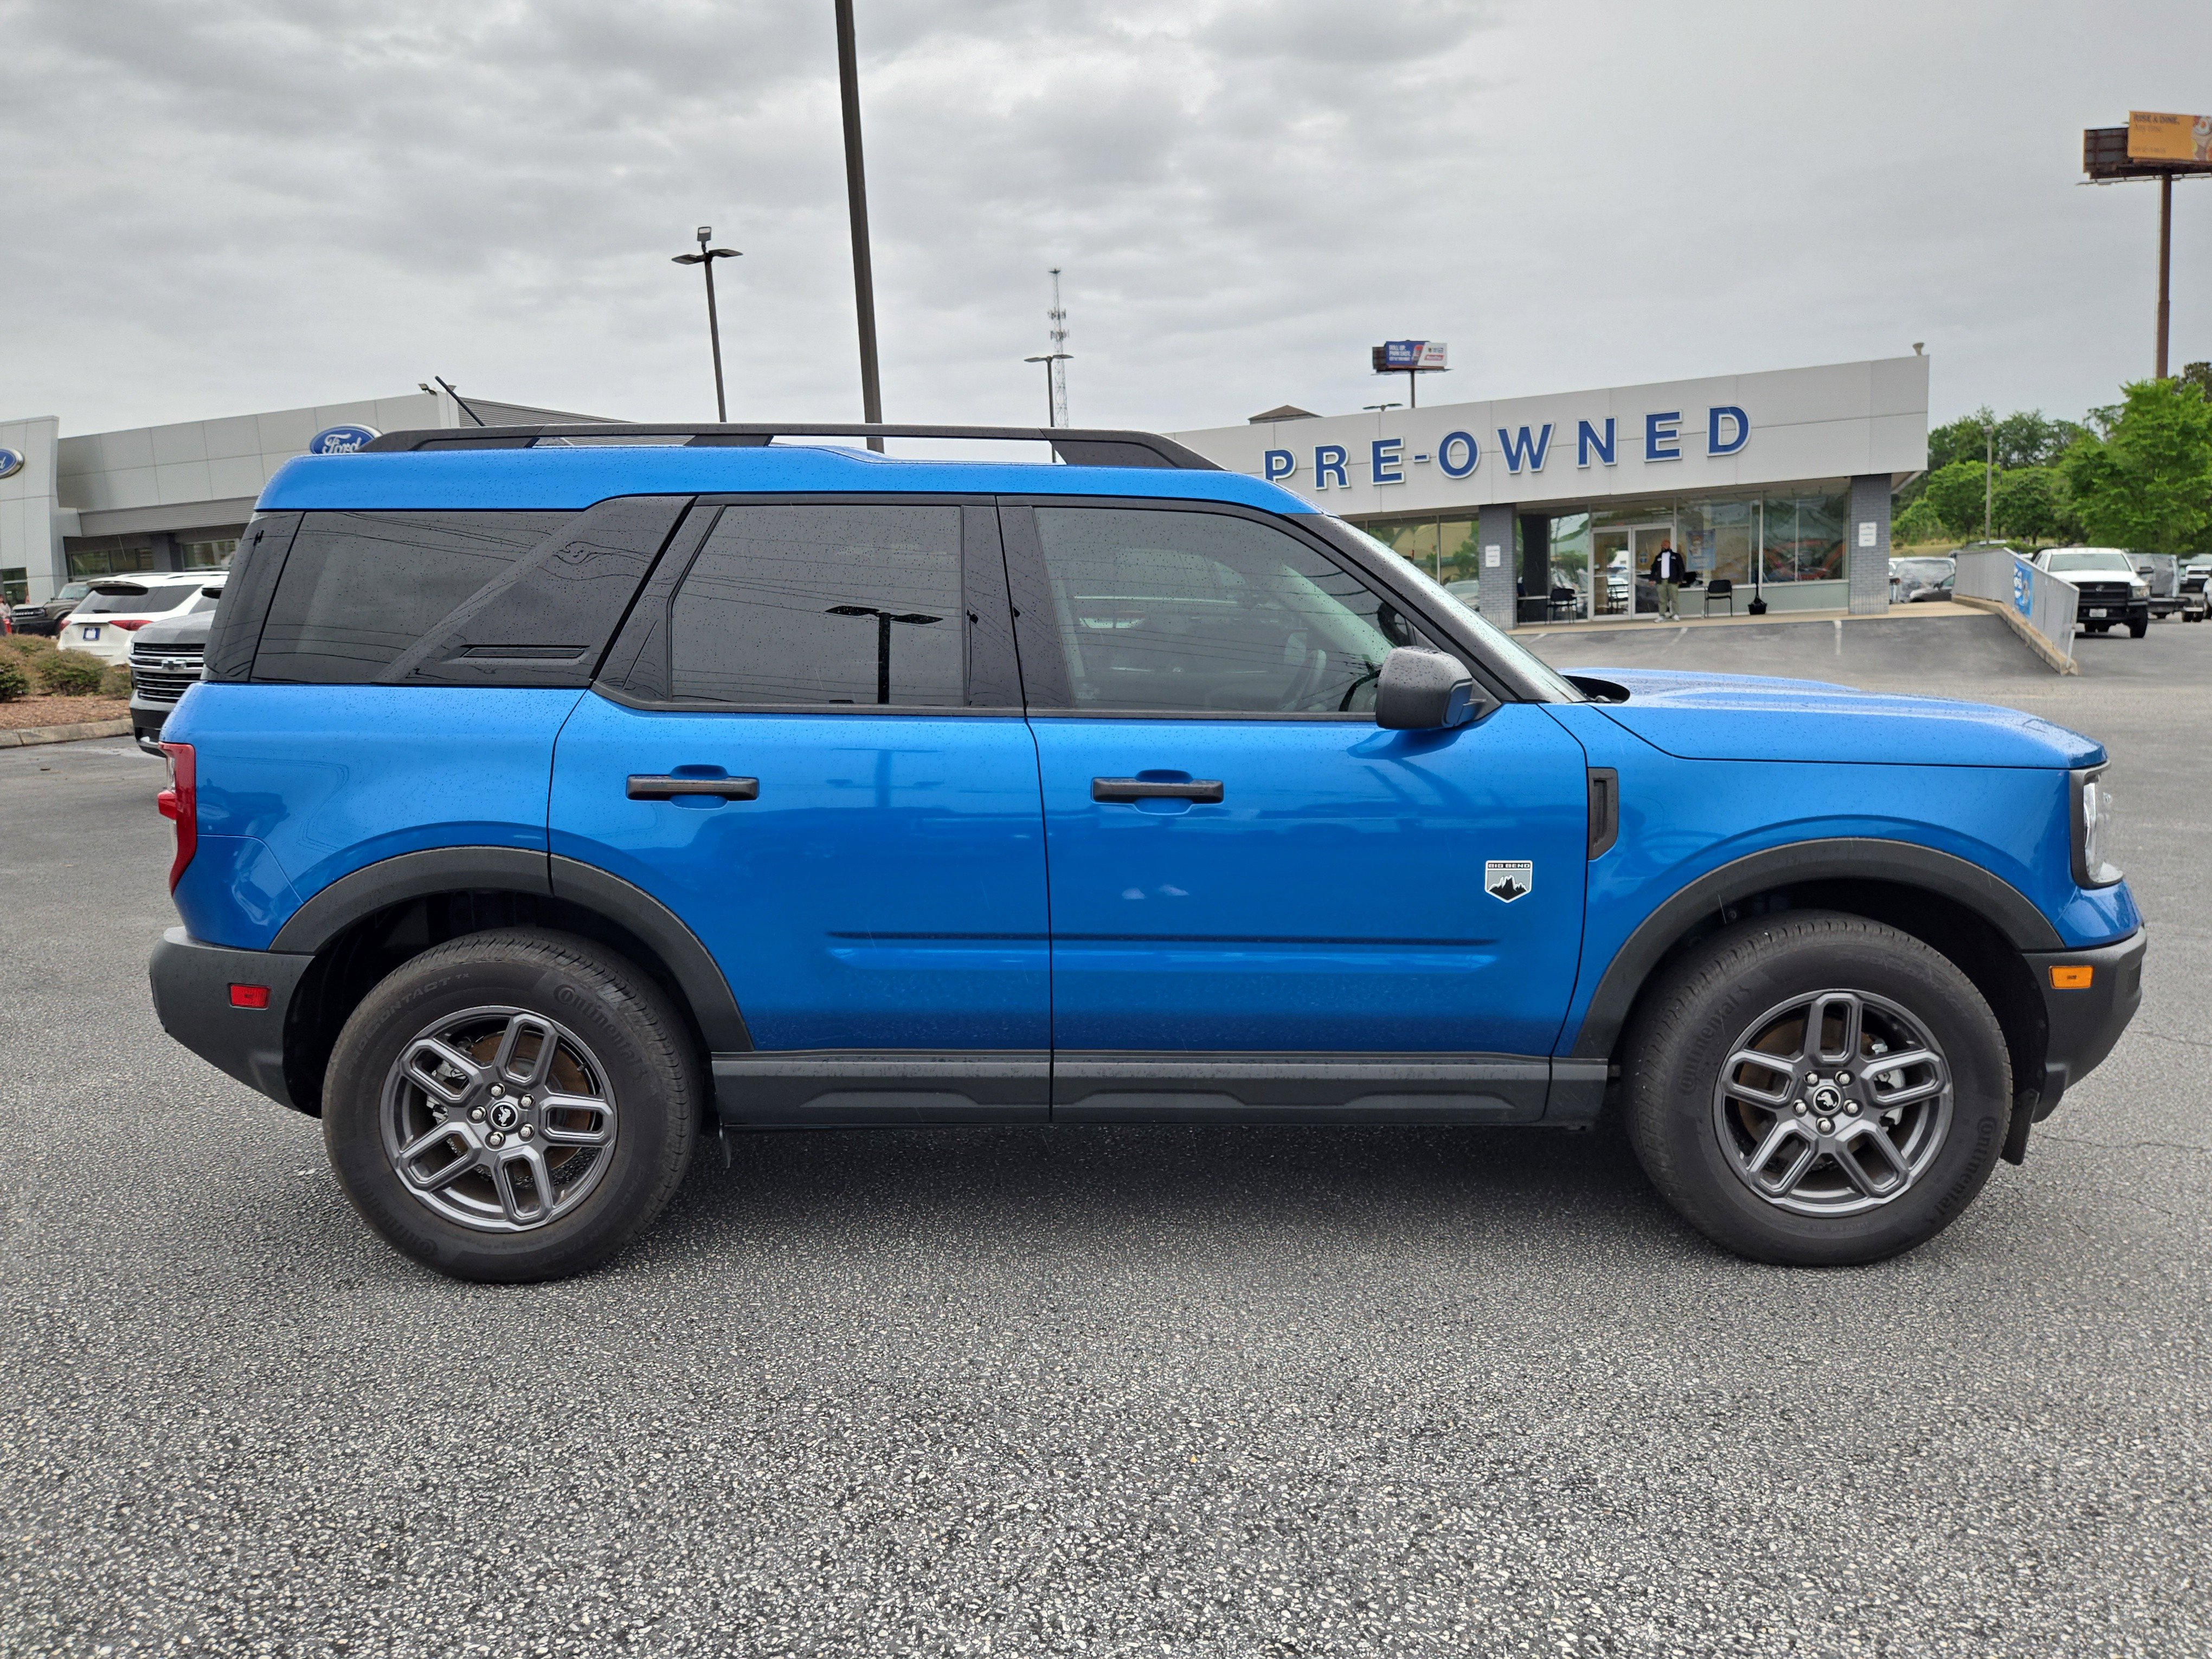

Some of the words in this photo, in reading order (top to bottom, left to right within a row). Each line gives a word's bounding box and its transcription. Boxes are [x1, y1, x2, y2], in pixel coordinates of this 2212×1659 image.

[322, 433, 362, 454] Ford
[1263, 405, 1751, 490] PRE-OWNED
[553, 983, 642, 1065] Continental
[1678, 994, 1740, 1095] Continental
[1934, 1115, 1997, 1218] Continental
